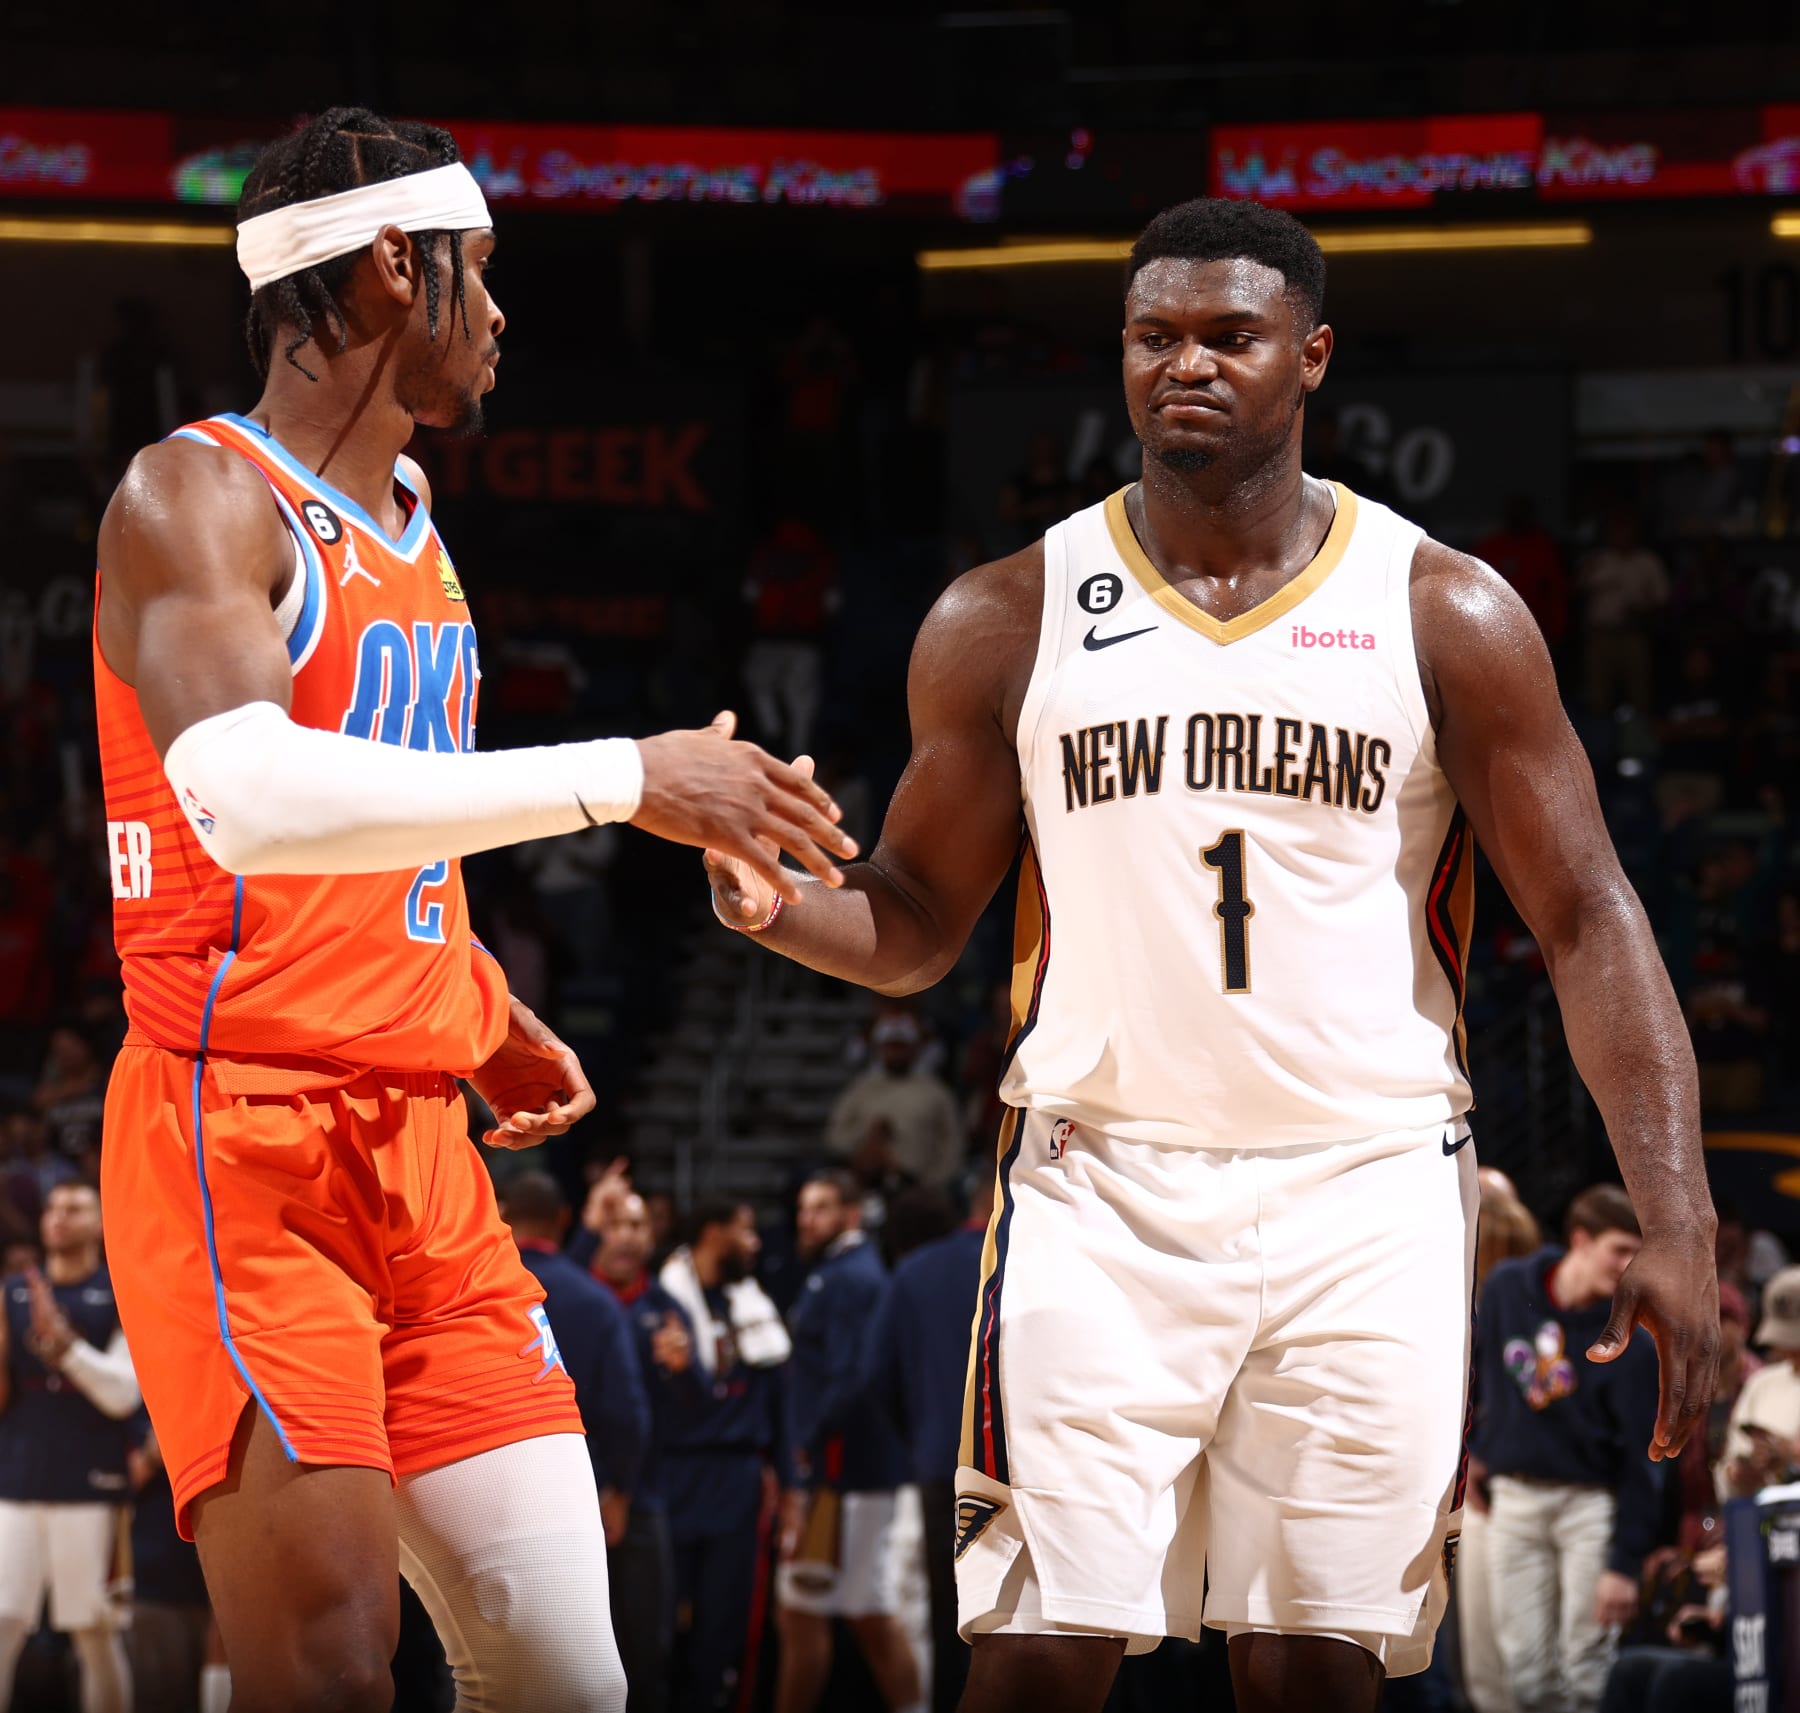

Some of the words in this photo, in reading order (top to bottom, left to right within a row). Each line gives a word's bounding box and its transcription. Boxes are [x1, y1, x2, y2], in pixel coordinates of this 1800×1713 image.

[412, 420, 712, 514] TGEEK
[305, 506, 337, 540] 6
[1087, 579, 1114, 609] 6
[1291, 626, 1376, 650] ibotta
[1059, 715, 1169, 813] NEW
[1183, 713, 1392, 814] ORLEANS
[405, 859, 448, 944] 2
[1199, 828, 1255, 995] 1
